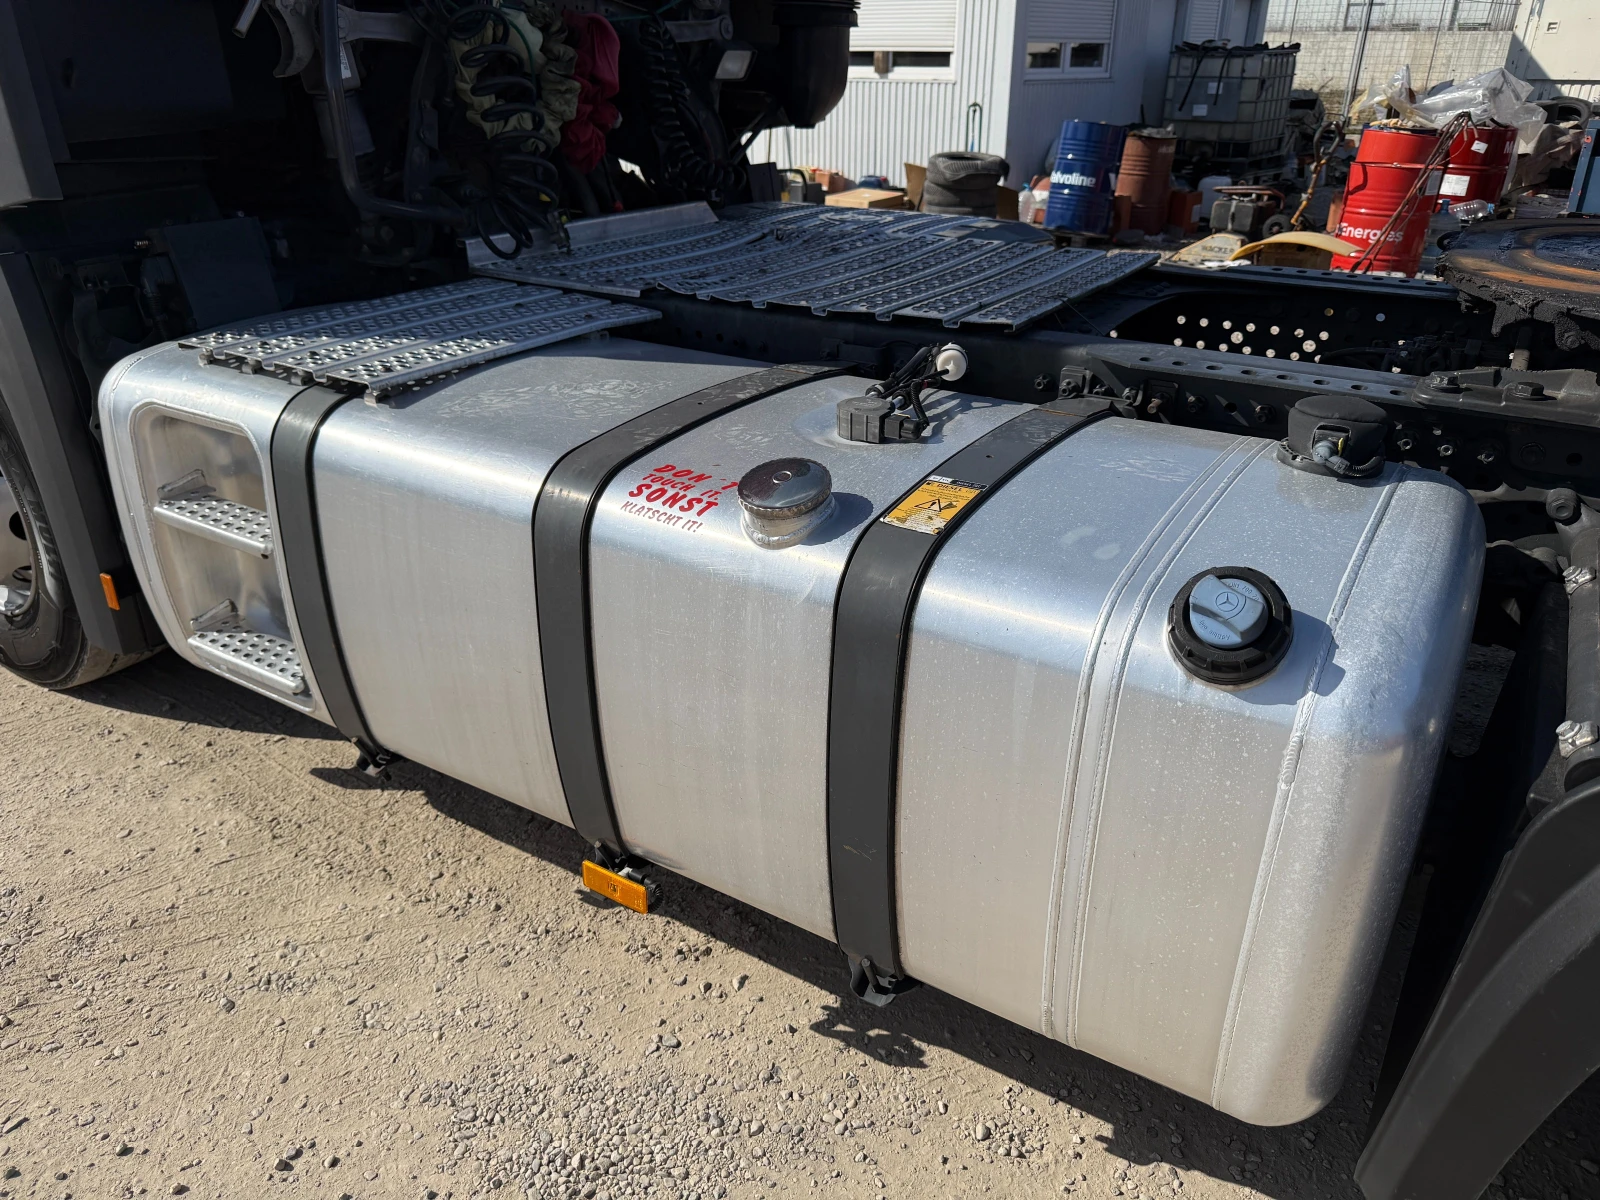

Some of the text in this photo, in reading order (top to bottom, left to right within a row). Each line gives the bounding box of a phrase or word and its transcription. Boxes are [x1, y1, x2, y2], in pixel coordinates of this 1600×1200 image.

[1050, 171, 1097, 188] alvoline
[642, 473, 696, 492] TOUCH
[628, 483, 719, 517] SONST
[620, 501, 683, 527] KLATSCHT
